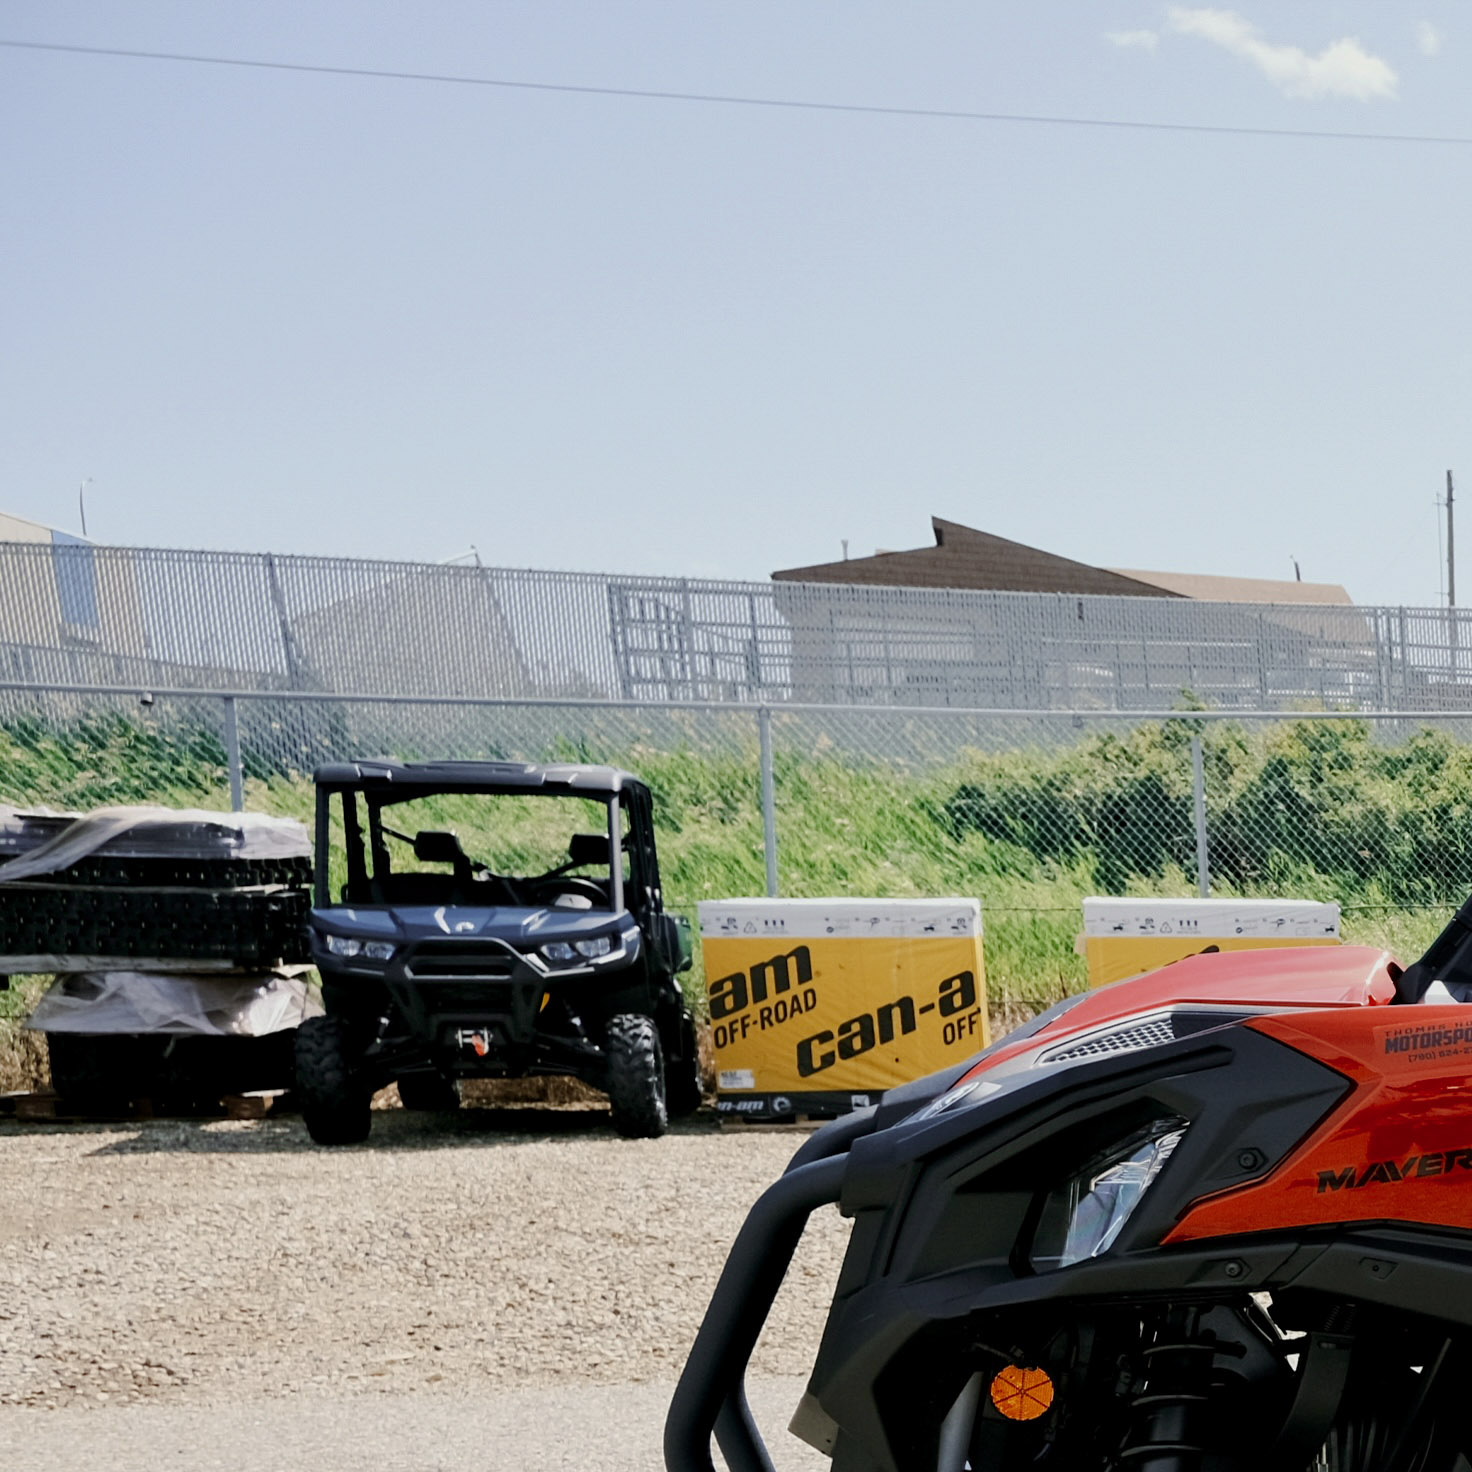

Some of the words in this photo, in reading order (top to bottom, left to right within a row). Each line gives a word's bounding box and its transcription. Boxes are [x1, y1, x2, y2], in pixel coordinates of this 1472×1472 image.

[713, 988, 817, 1050] OFF-ROAD
[942, 1008, 980, 1046] OFF
[1384, 1023, 1446, 1037] THOMAS
